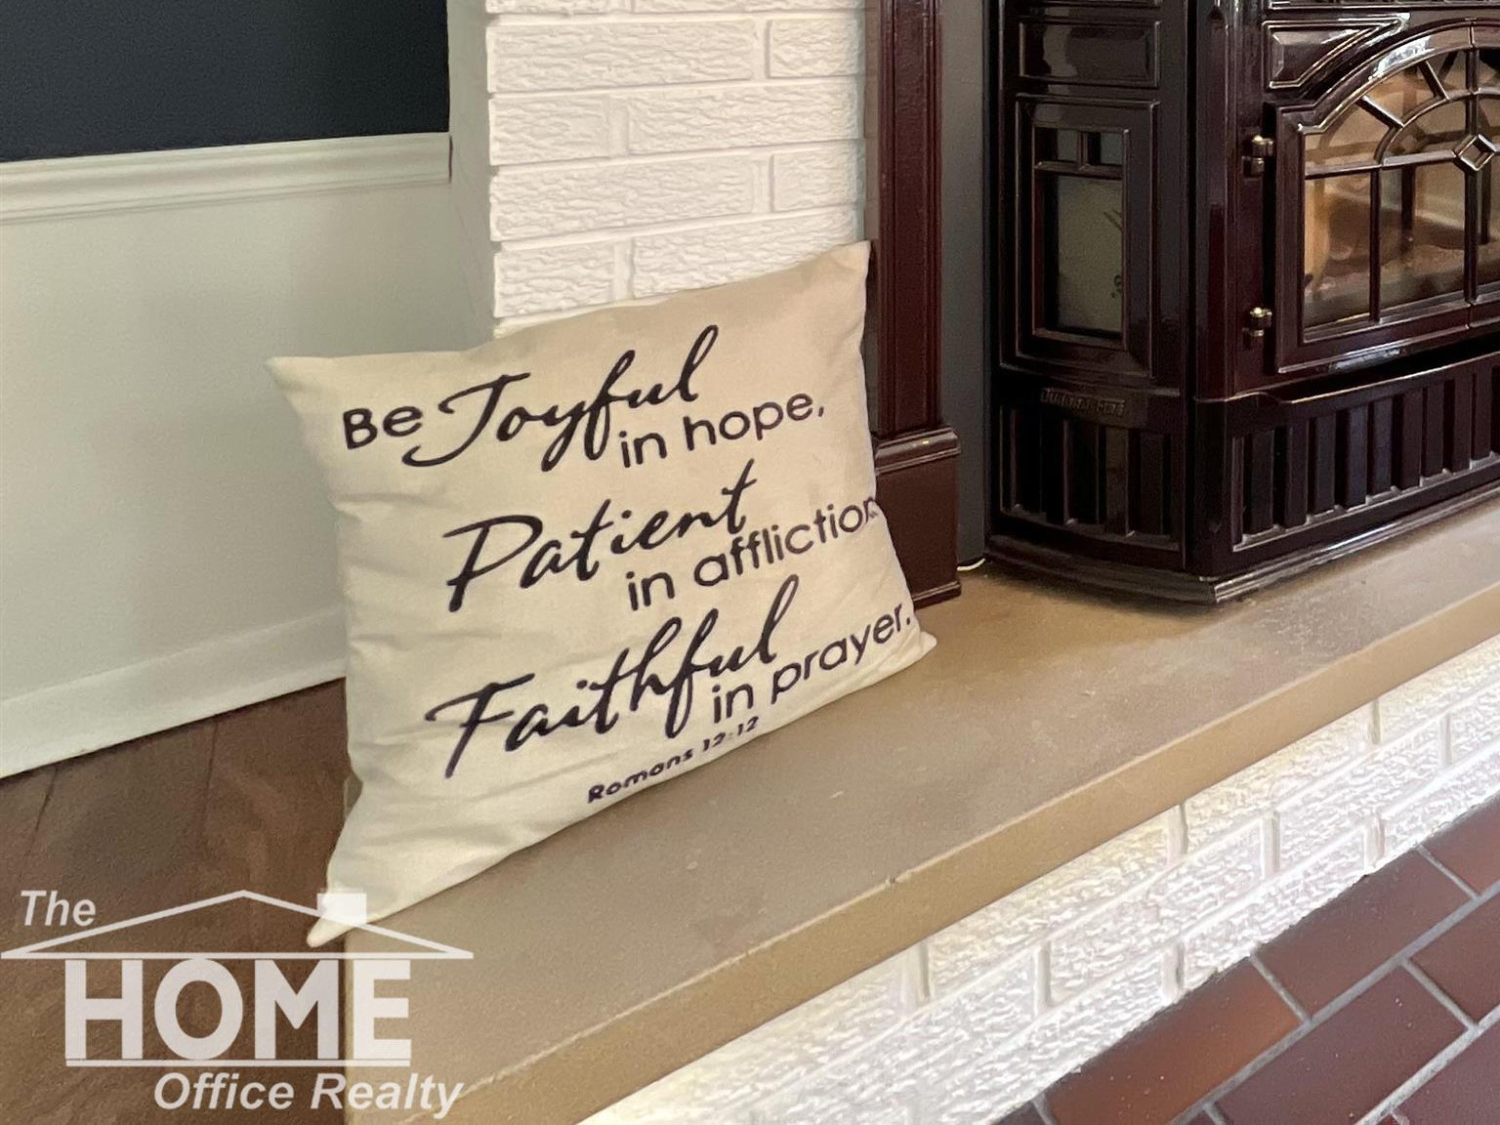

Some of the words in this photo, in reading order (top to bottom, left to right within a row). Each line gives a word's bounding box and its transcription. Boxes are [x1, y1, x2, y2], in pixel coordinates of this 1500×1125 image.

[342, 405, 423, 451] Be
[401, 324, 719, 473] Joyful
[617, 429, 668, 469] in
[682, 392, 825, 452] hope,
[442, 458, 758, 613] Patient
[625, 570, 675, 612] in
[424, 573, 800, 779] Faithful
[710, 683, 754, 724] in
[771, 603, 911, 705] prayer.
[587, 748, 694, 804] Romans
